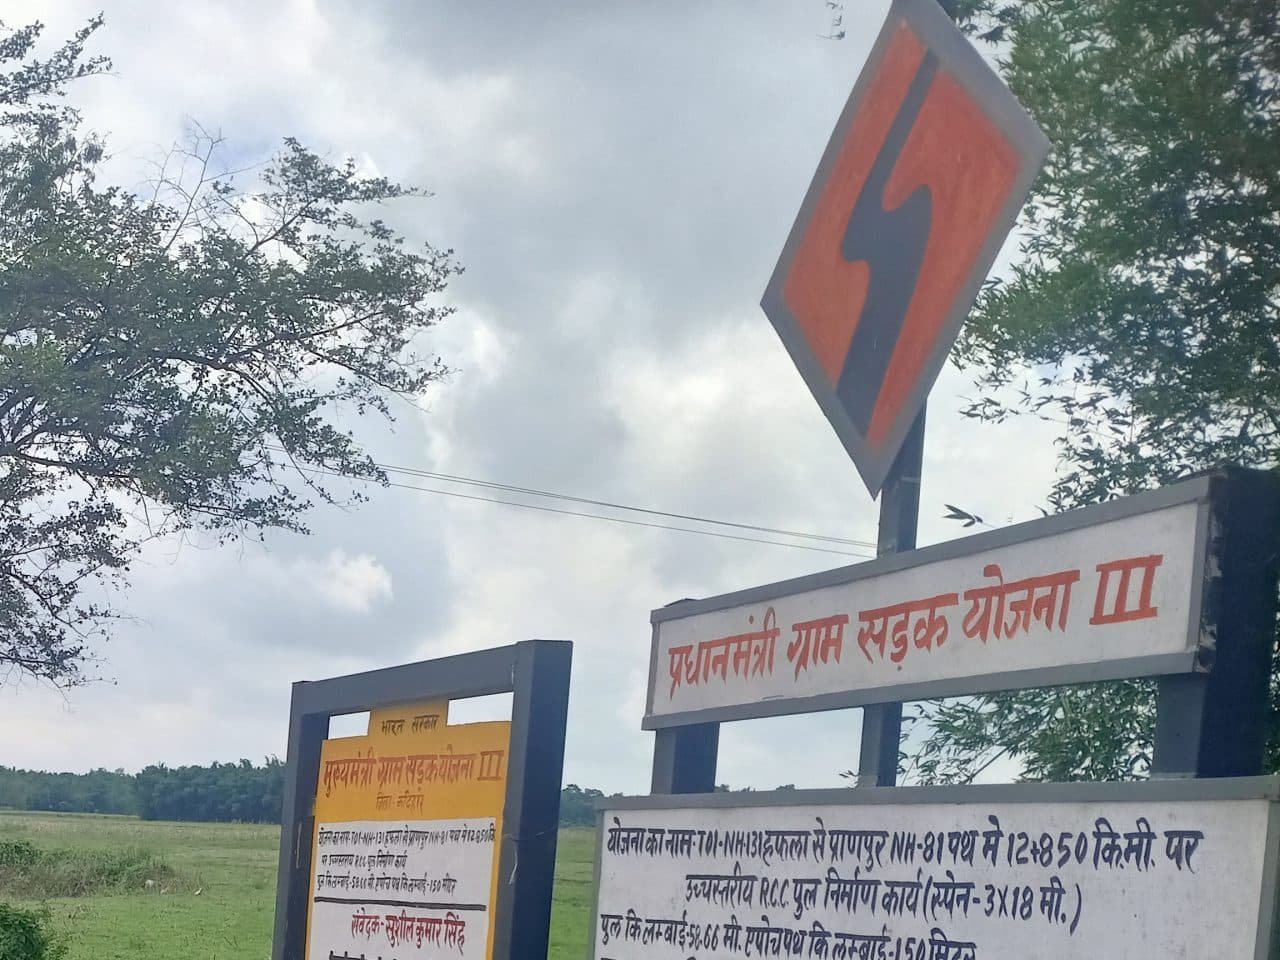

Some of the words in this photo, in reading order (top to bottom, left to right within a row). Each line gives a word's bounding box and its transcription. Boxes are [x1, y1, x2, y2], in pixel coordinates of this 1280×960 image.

[668, 606, 780, 700] प्रधानमंत्री
[786, 614, 849, 681] ग्राम
[857, 593, 959, 671] सड़क
[962, 564, 1080, 644] योजना
[1089, 554, 1163, 625] III
[607, 816, 646, 857] योजना
[645, 828, 665, 858] का
[812, 817, 826, 863] से
[828, 830, 889, 872] प्राणपुर
[890, 831, 945, 866] NH-81
[948, 830, 979, 867] पथ
[1164, 830, 1204, 874] पर
[792, 878, 822, 920] पुल
[823, 865, 882, 916] निर्माण
[881, 868, 923, 918] कार्य
[385, 909, 416, 948] सुशील
[416, 918, 442, 948] कुमार
[443, 911, 465, 956] सिंह
[600, 913, 623, 945] पुल
[625, 908, 642, 942] कि
[808, 920, 832, 960] कि
